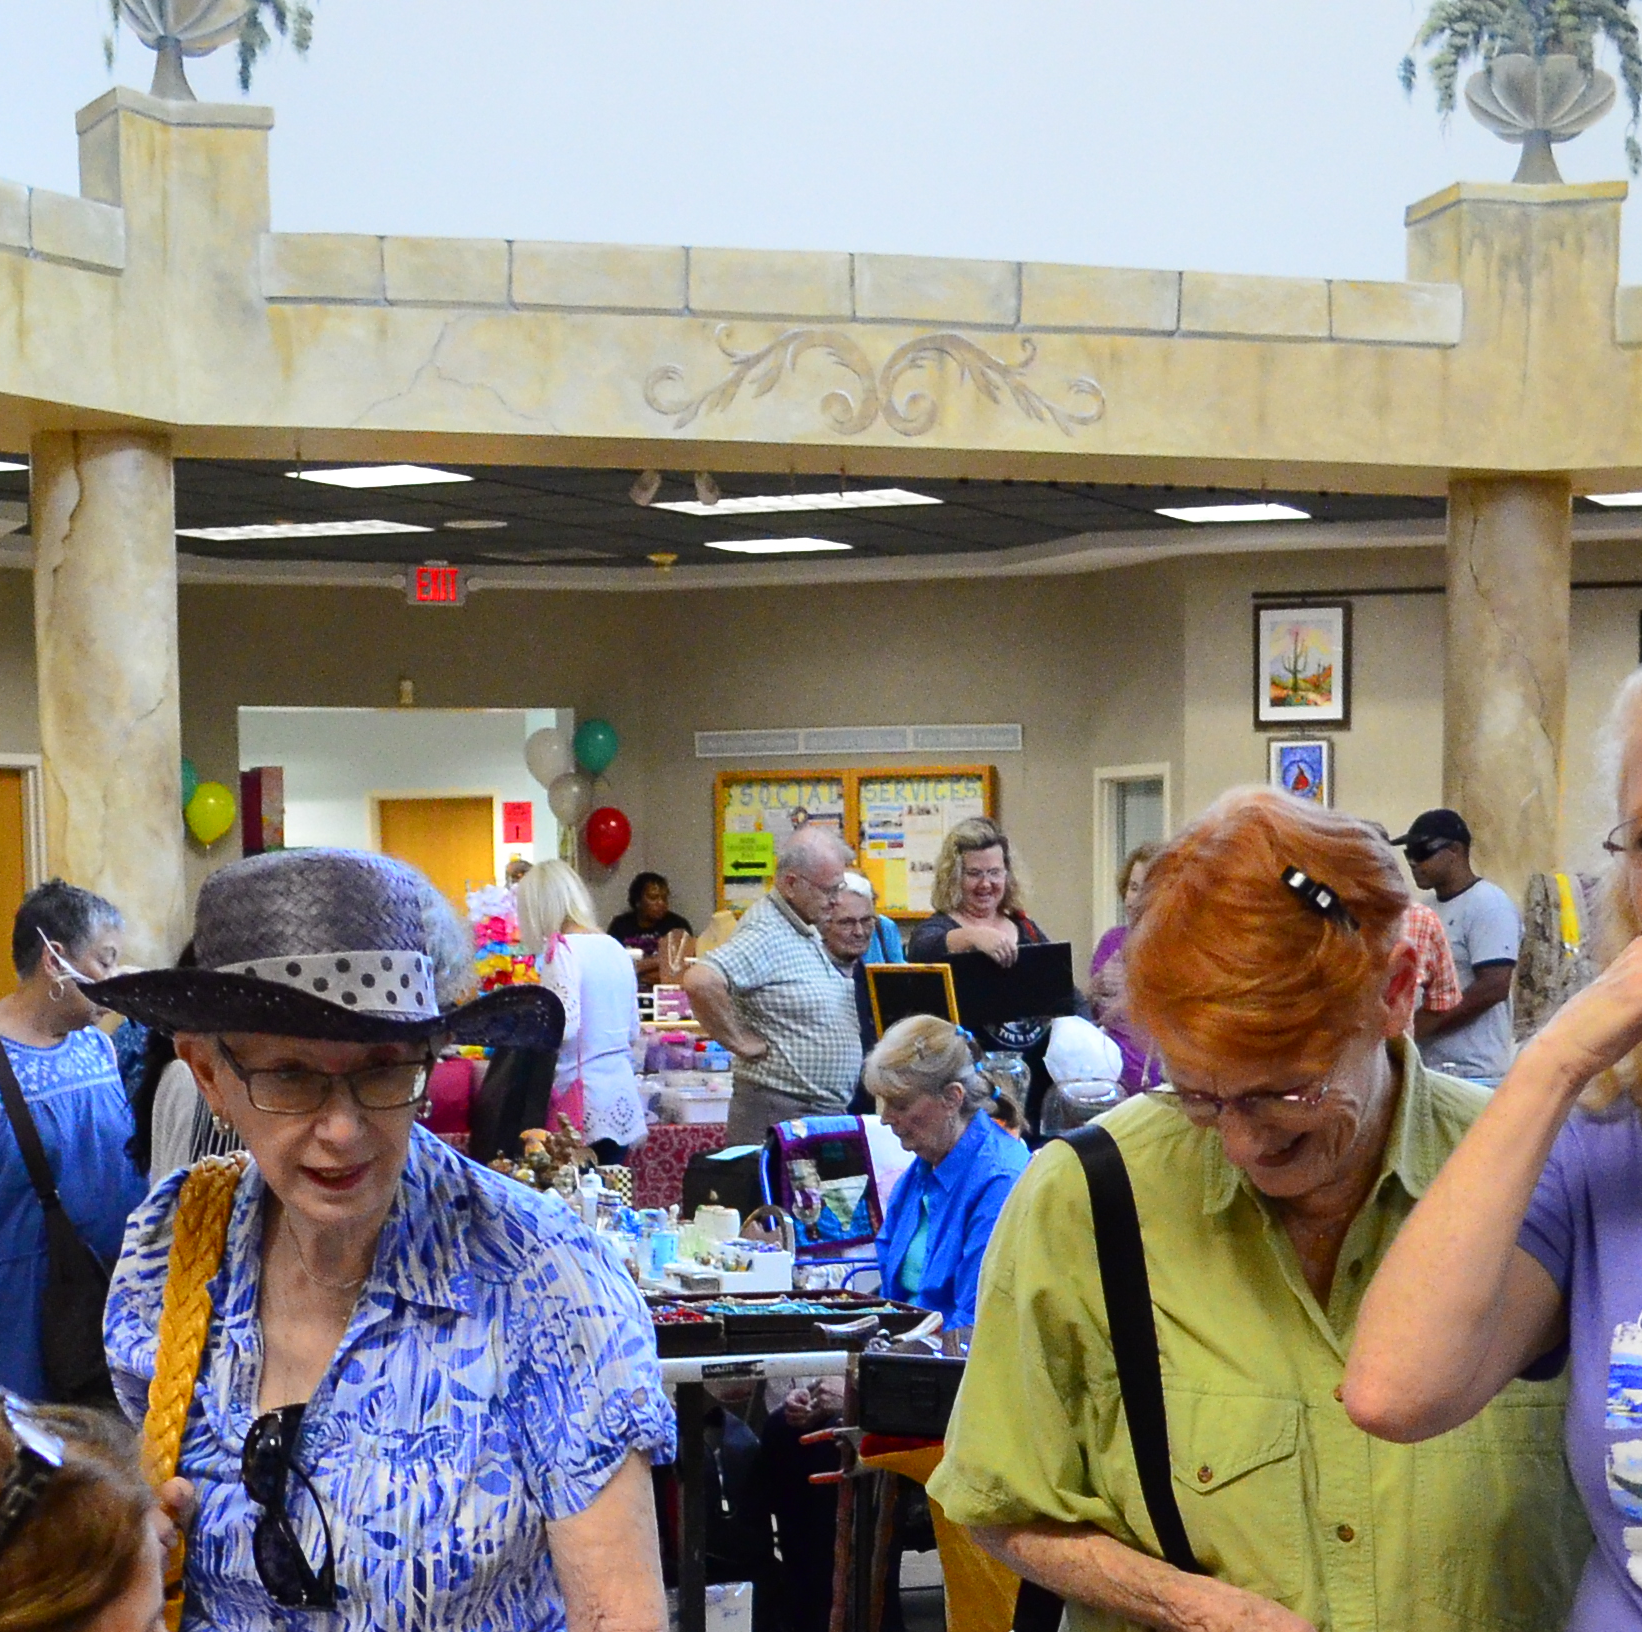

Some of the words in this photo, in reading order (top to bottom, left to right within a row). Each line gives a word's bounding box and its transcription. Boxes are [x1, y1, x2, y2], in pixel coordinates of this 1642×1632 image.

[416, 566, 459, 602] EXIT
[740, 779, 841, 807] SOCIAL
[864, 778, 979, 802] SERVICES
